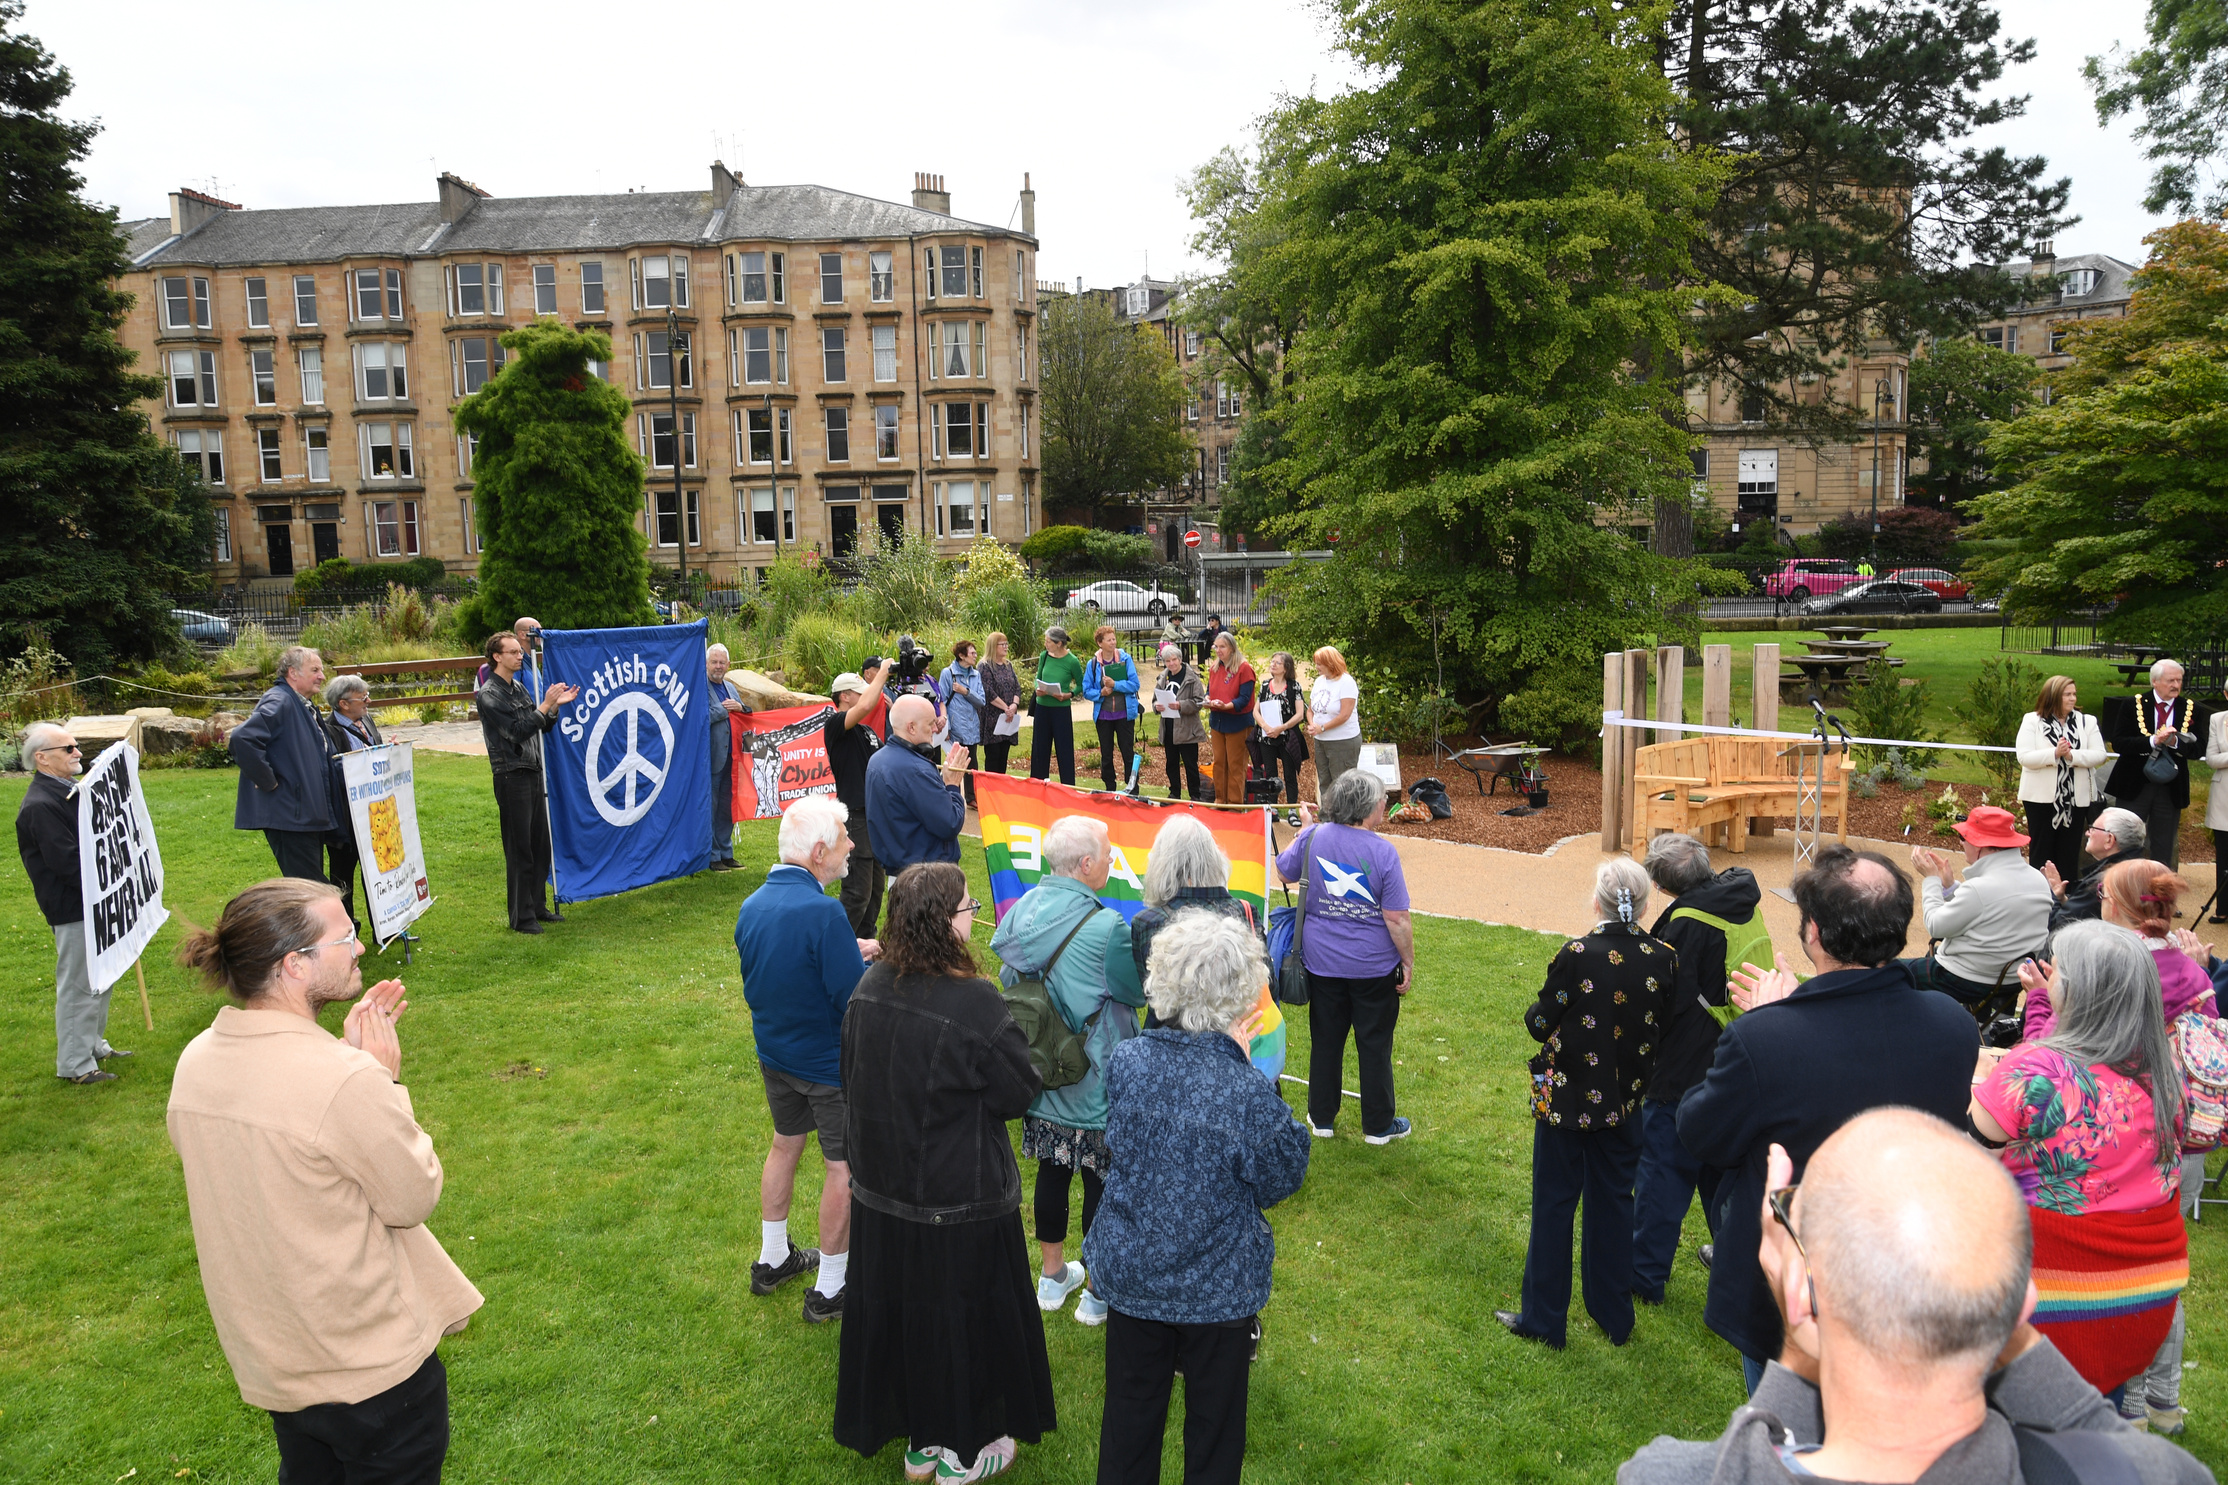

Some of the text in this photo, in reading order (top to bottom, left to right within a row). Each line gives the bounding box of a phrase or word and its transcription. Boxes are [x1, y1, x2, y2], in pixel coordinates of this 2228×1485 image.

[560, 653, 690, 742] Scottish CND
[783, 747, 826, 762] UNITY IS
[779, 787, 807, 801] TRADE
[93, 877, 138, 957] NEVER
